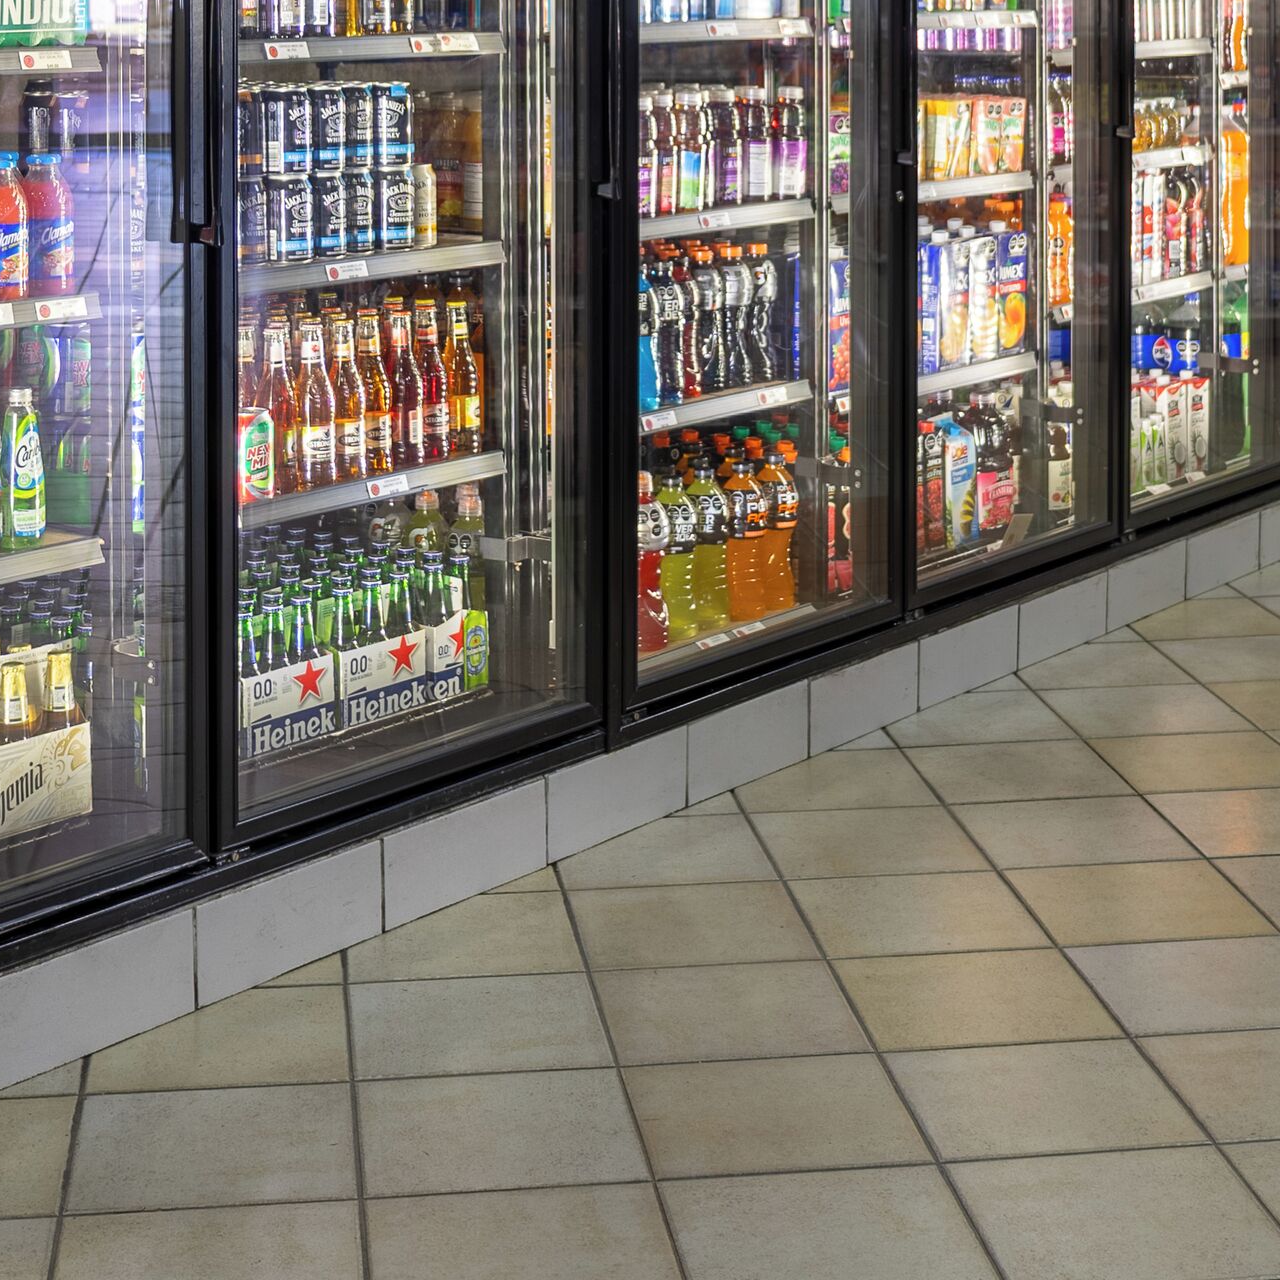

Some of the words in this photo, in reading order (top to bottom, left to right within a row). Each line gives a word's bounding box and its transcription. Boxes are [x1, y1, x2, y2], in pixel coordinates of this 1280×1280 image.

[350, 655, 368, 676] 0.0
[254, 677, 273, 700] 0.0
[349, 681, 426, 726] Heinek
[253, 707, 335, 754] Heinek
